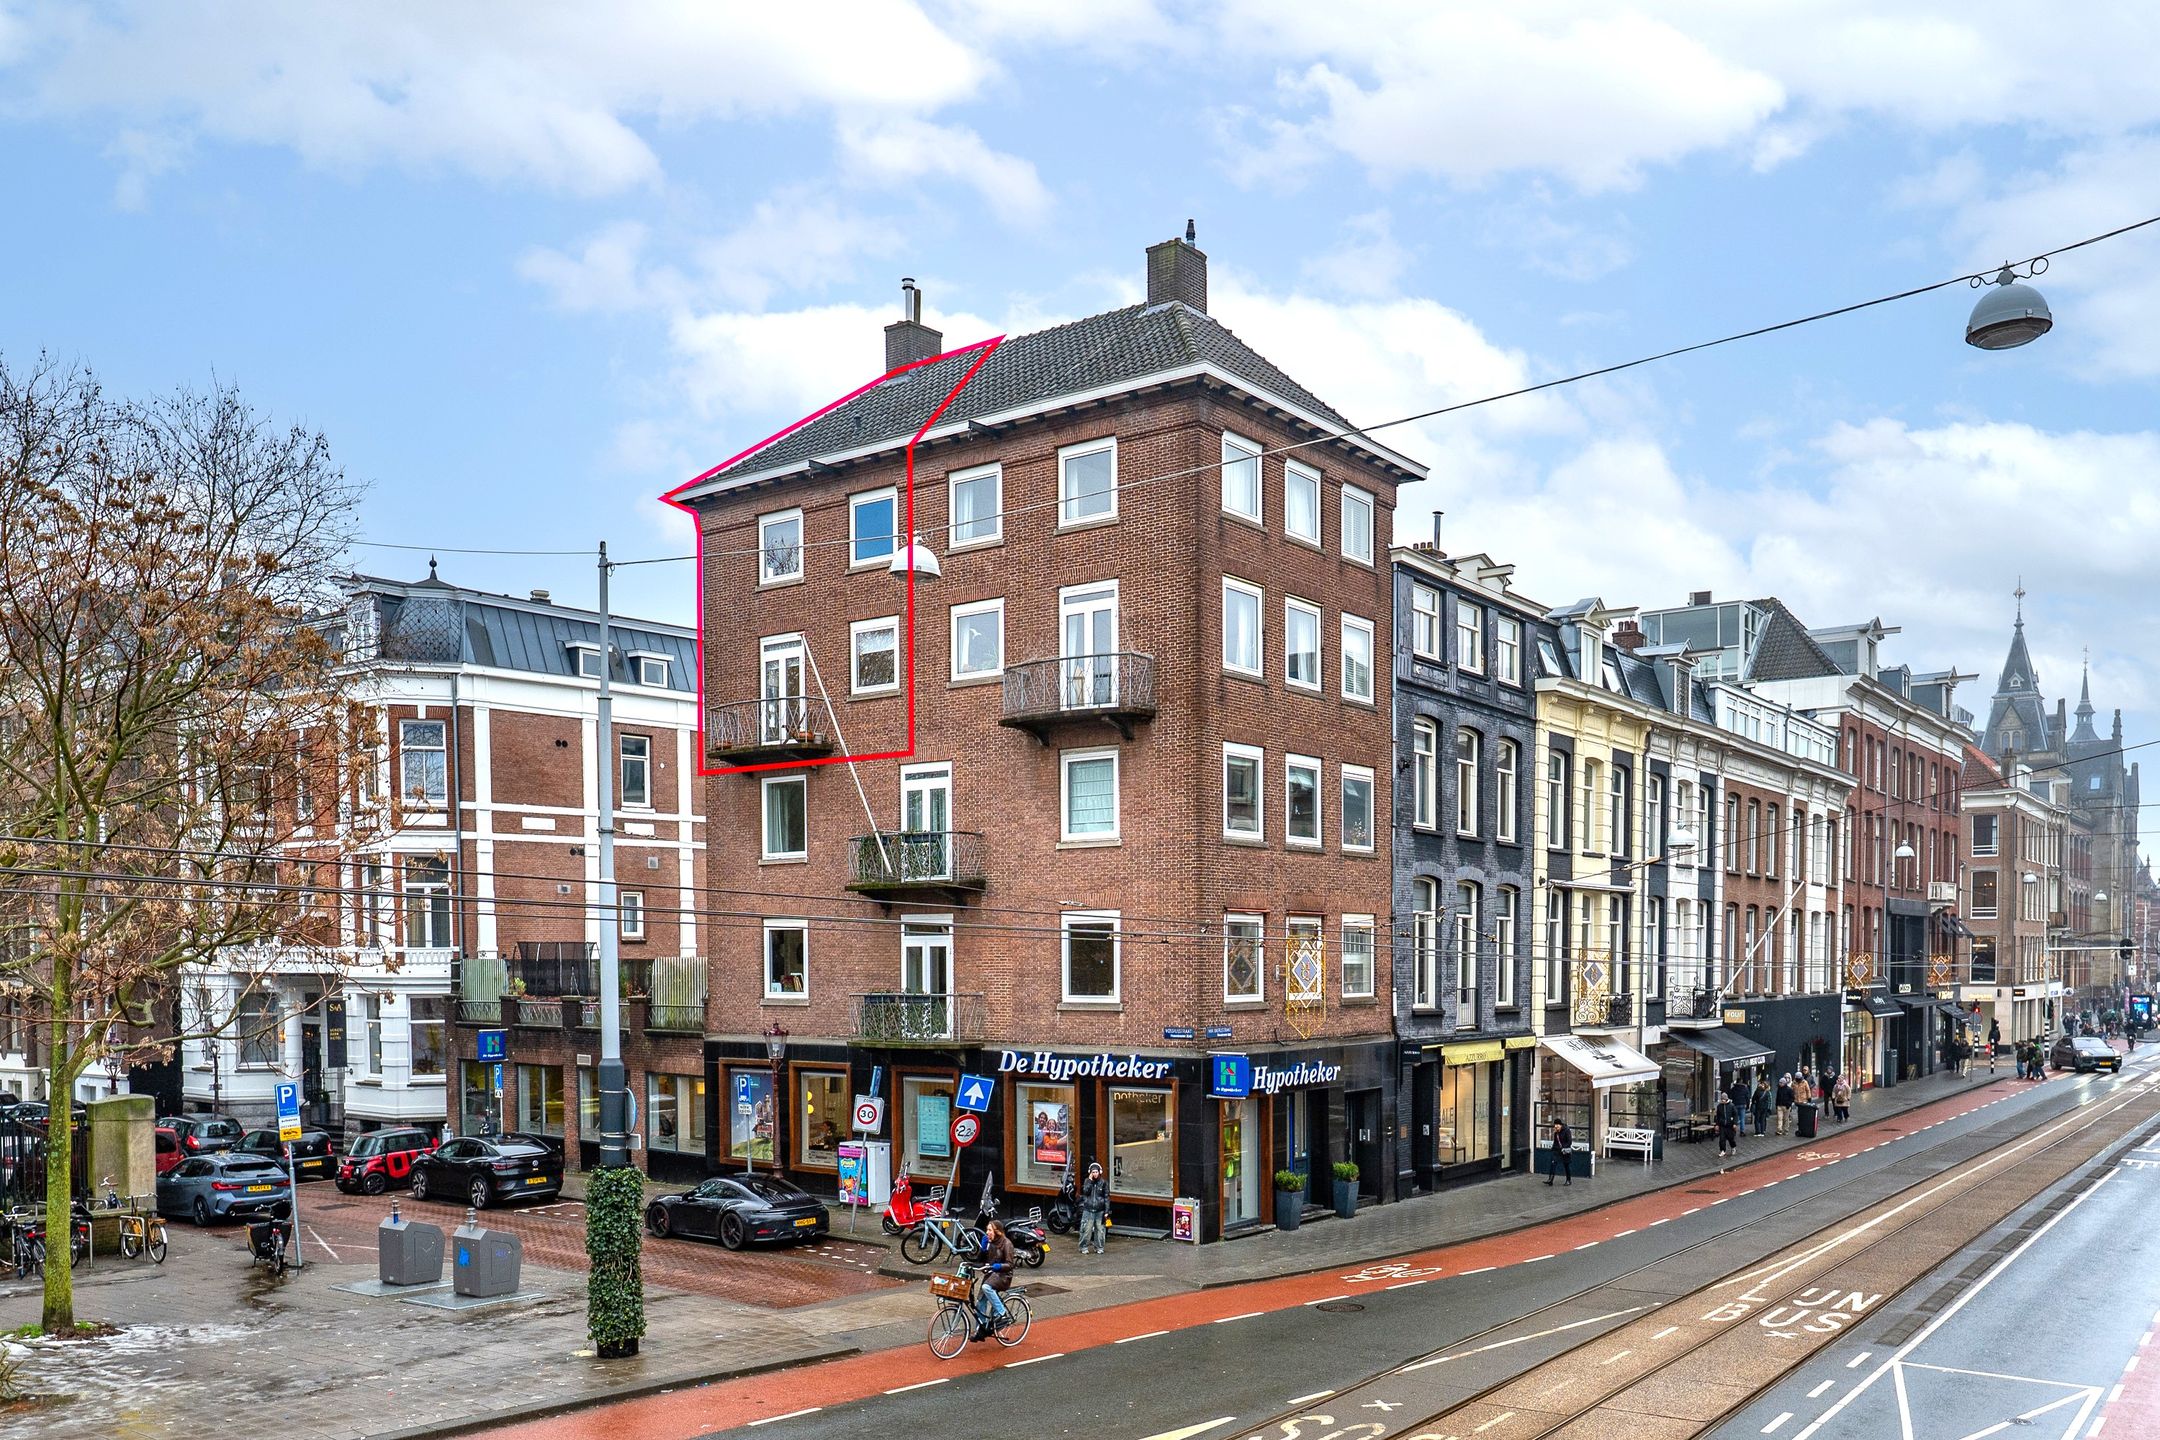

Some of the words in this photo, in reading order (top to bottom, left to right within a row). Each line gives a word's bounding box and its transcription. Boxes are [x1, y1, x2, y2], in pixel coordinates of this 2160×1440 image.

[998, 1050, 1027, 1073] De
[1031, 1052, 1169, 1081] Hypotheker
[739, 1077, 747, 1092] P
[1252, 1060, 1341, 1095] Hypotheker
[280, 1086, 293, 1104] P
[860, 1109, 874, 1119] 30
[1441, 1106, 1454, 1126] ALE
[1699, 1302, 1853, 1333] BUS
